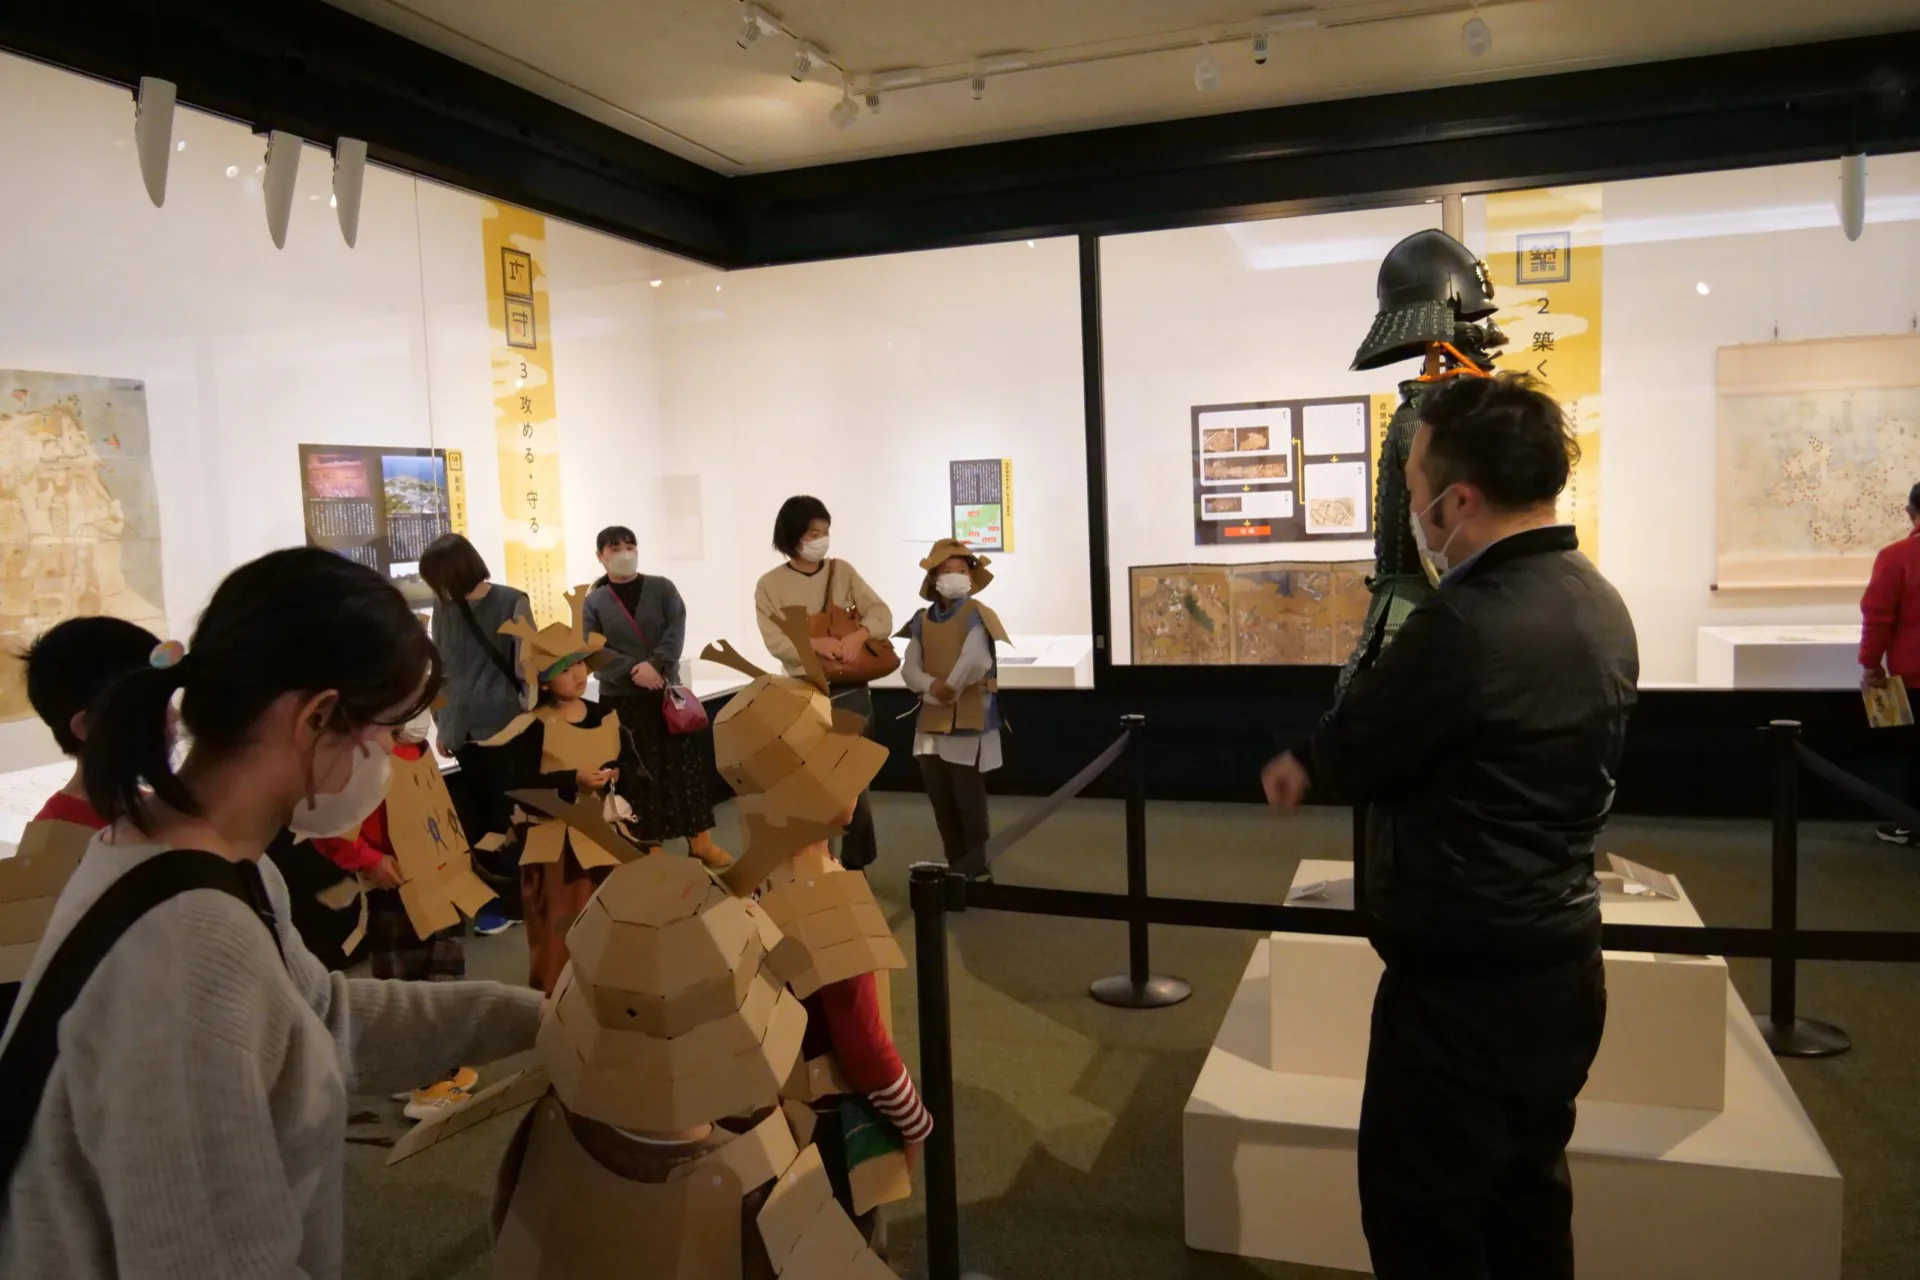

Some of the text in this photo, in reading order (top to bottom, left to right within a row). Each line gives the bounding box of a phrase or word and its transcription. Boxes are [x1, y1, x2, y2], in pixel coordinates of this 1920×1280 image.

[1536, 297, 1551, 315] 2
[519, 362, 528, 379] 3
[1532, 330, 1555, 379] 築く
[519, 395, 540, 534] 攻める・守る
